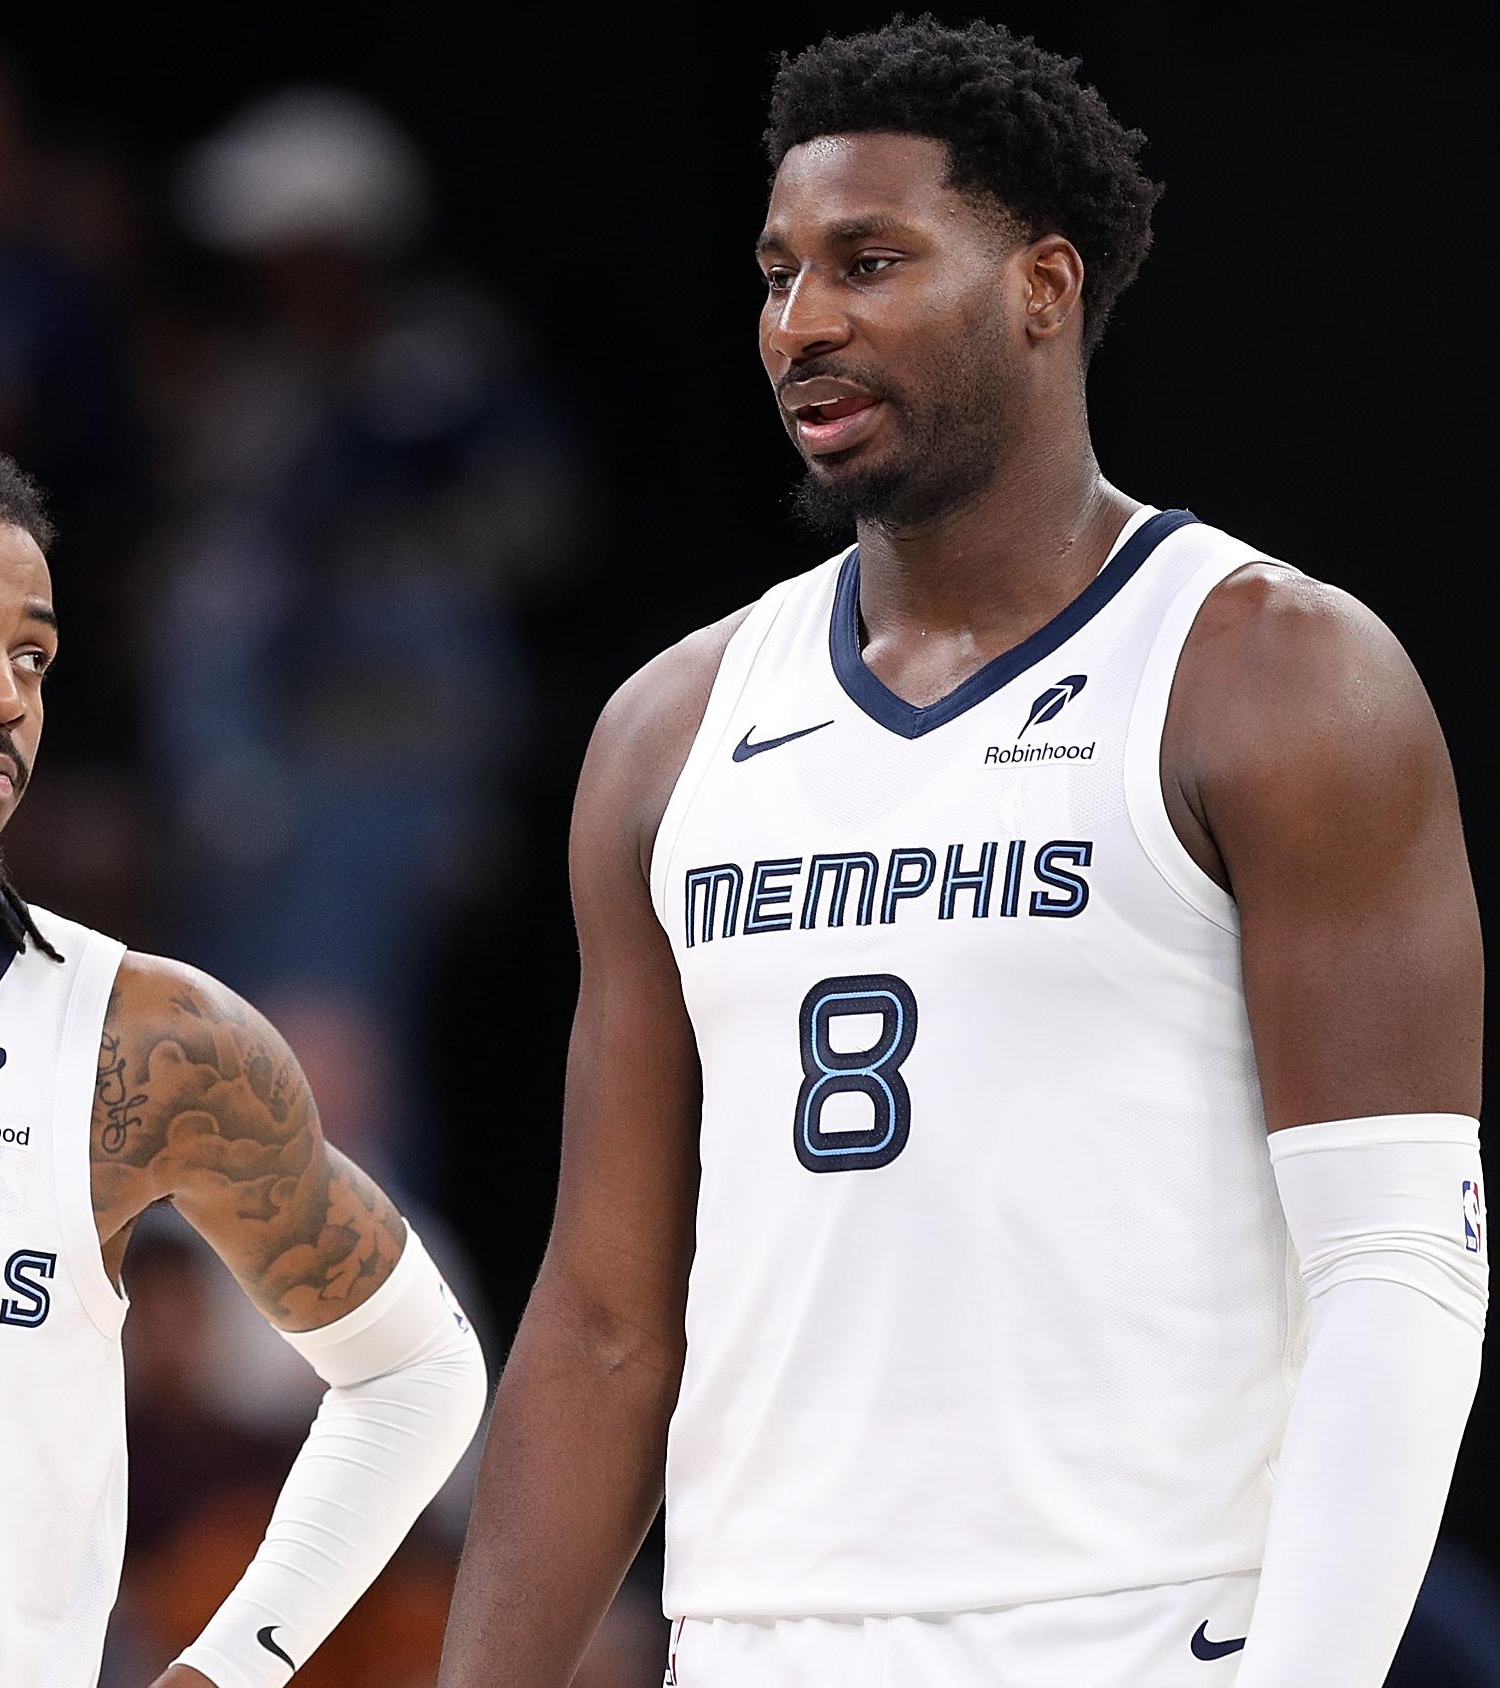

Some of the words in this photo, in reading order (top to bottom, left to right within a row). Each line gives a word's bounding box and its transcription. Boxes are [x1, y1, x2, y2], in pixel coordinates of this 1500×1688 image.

[984, 741, 1096, 765] Robinhood
[684, 839, 1094, 949] MEMPHIS
[792, 973, 919, 1174] 8
